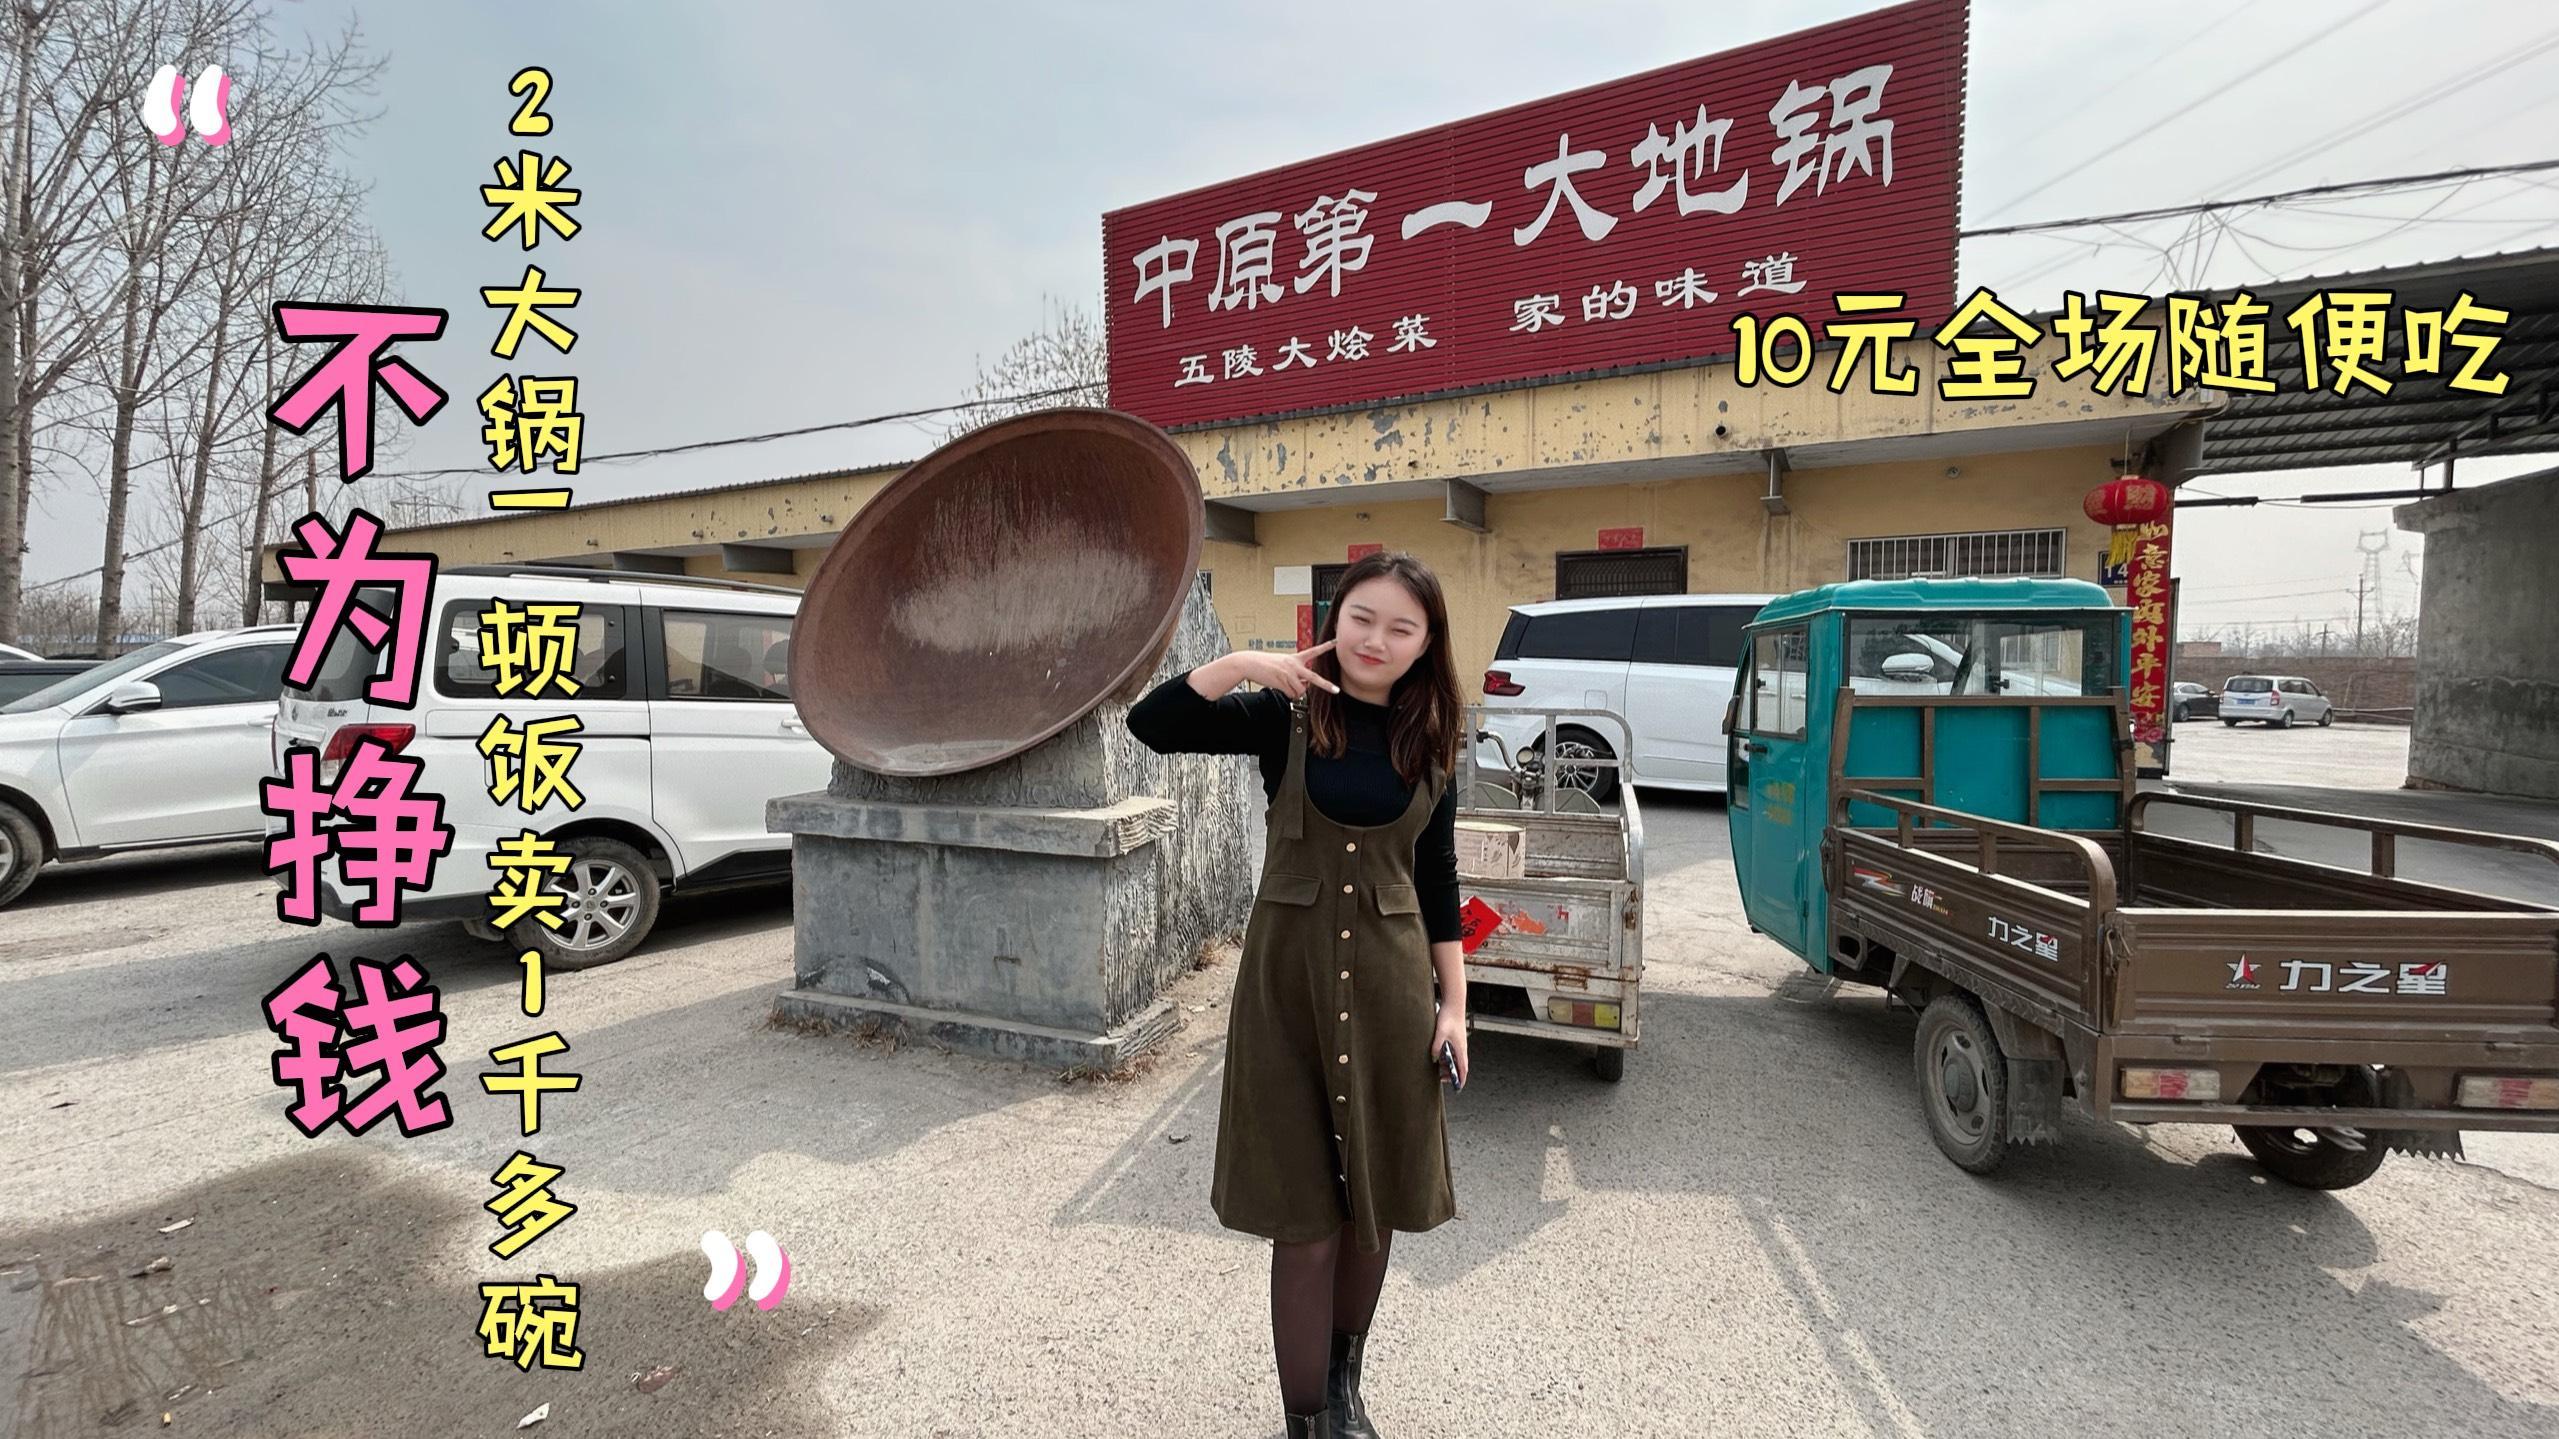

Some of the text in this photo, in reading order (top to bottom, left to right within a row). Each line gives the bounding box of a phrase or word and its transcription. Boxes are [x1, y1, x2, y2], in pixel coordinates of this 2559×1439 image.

[1132, 63, 1895, 330] 中原第一大地锅
[1174, 251, 1808, 388] 五陵大烩菜 家的味道
[1988, 916, 2058, 962] 力之星
[2279, 959, 2448, 995] 力之星
